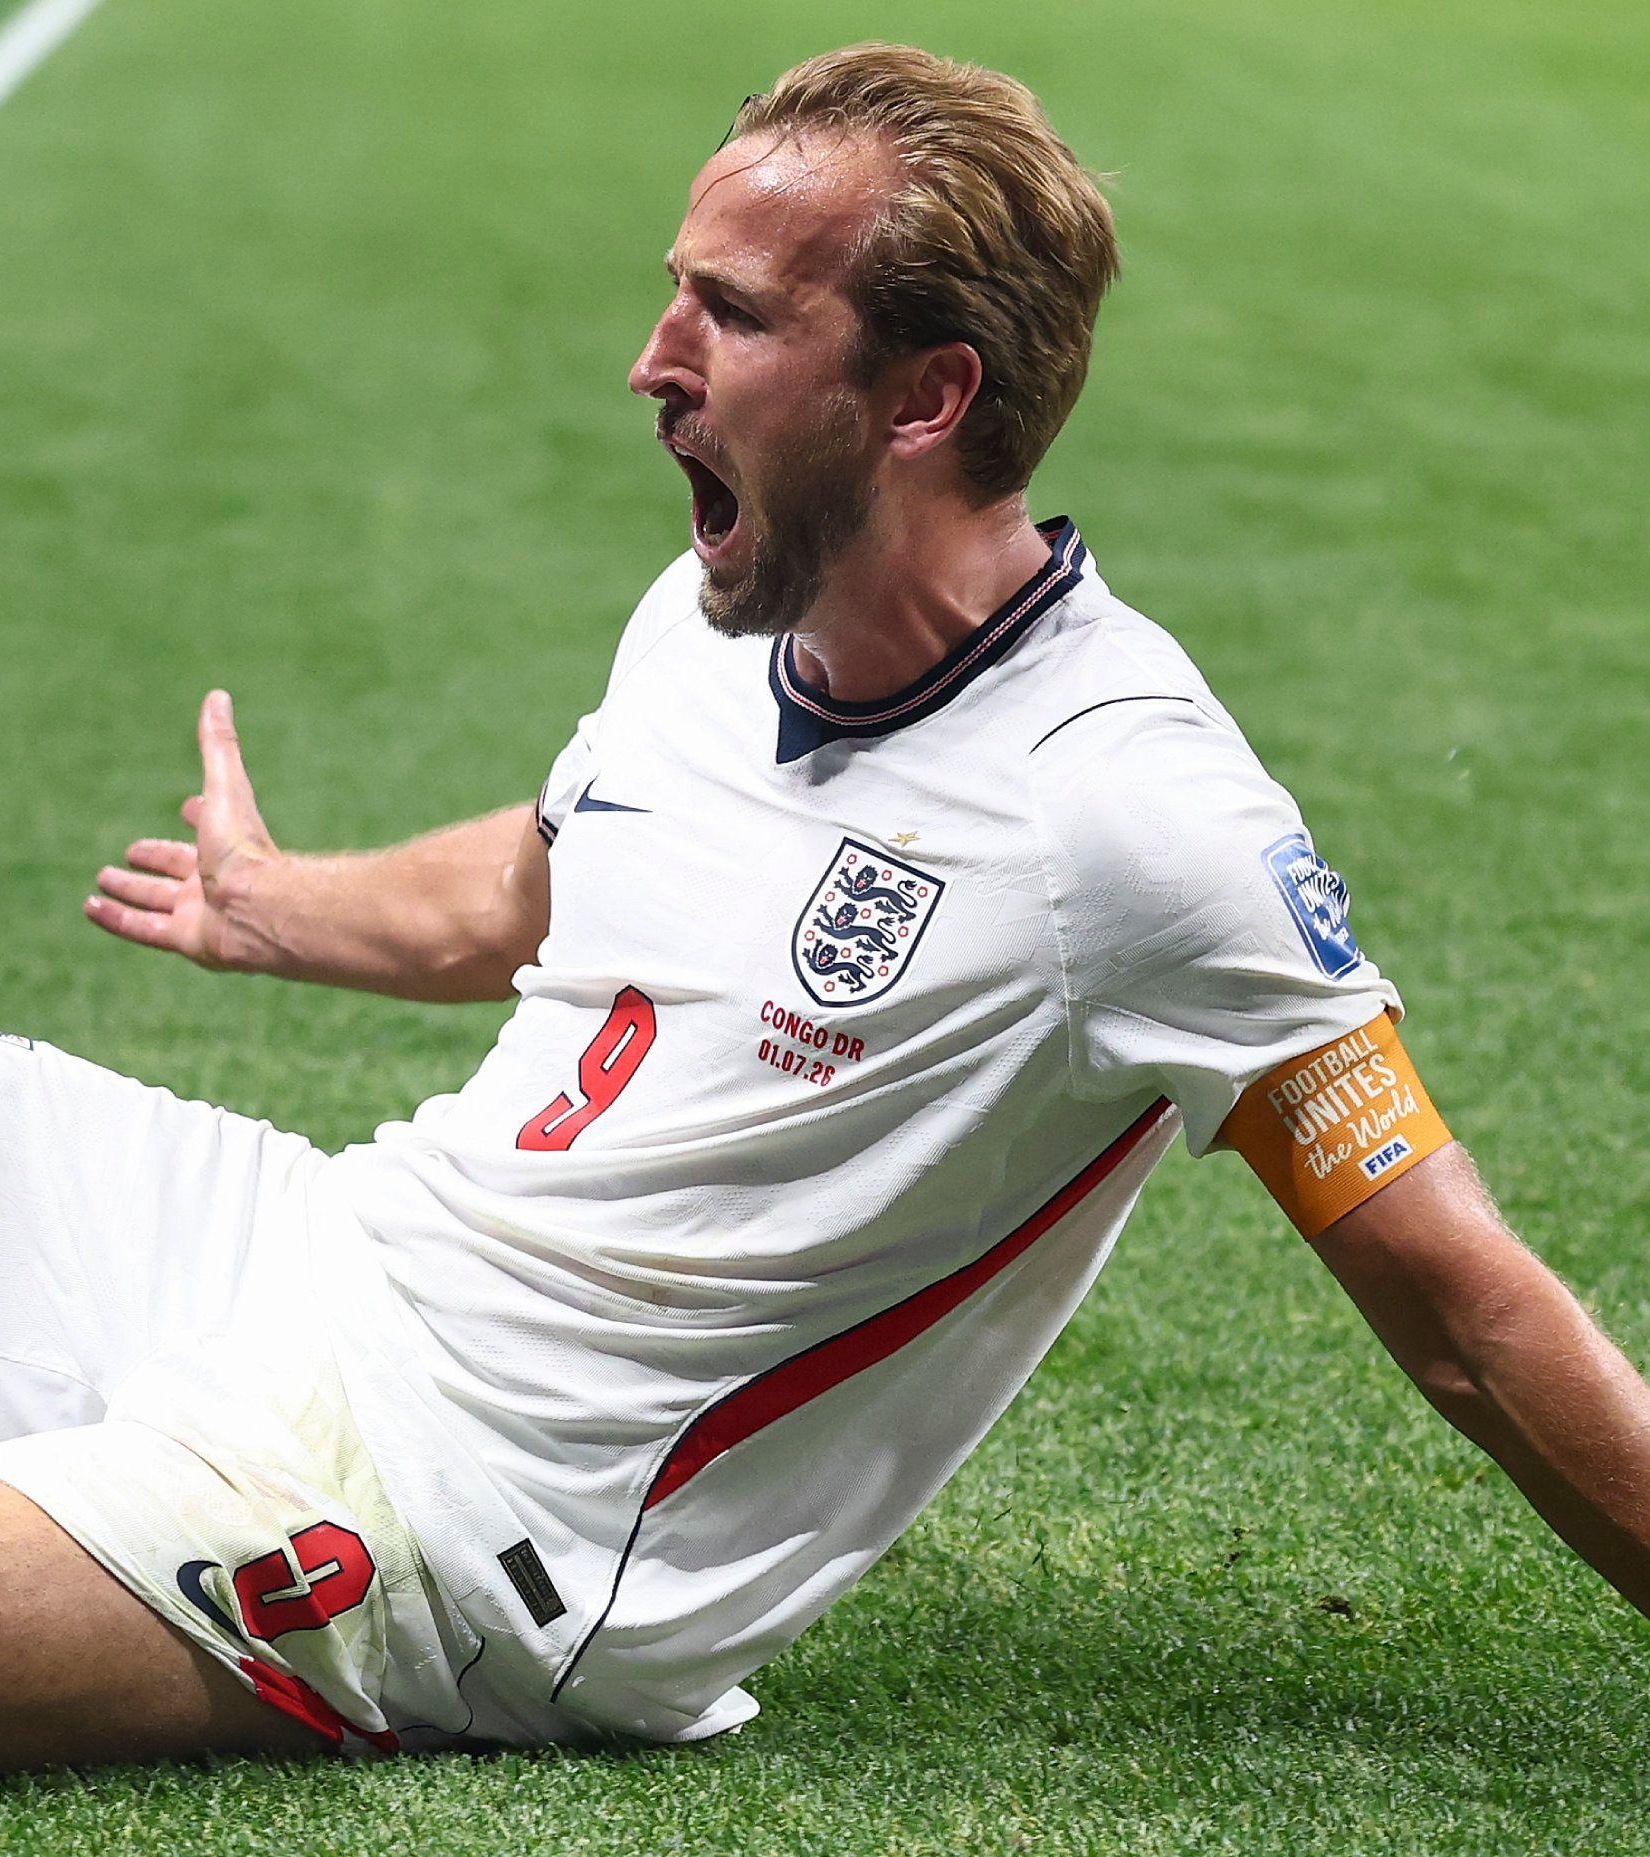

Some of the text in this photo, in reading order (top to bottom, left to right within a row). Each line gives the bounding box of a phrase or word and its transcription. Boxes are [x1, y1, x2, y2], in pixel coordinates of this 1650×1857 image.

[516, 984, 657, 1151] 9
[758, 1039, 835, 1087] 01.07.26
[760, 1000, 865, 1062] CONGO DR
[1267, 1029, 1381, 1114] FOOTBALL
[1282, 1053, 1397, 1145] UNITES
[1304, 1084, 1421, 1180] the World
[1364, 1141, 1408, 1176] FIFA
